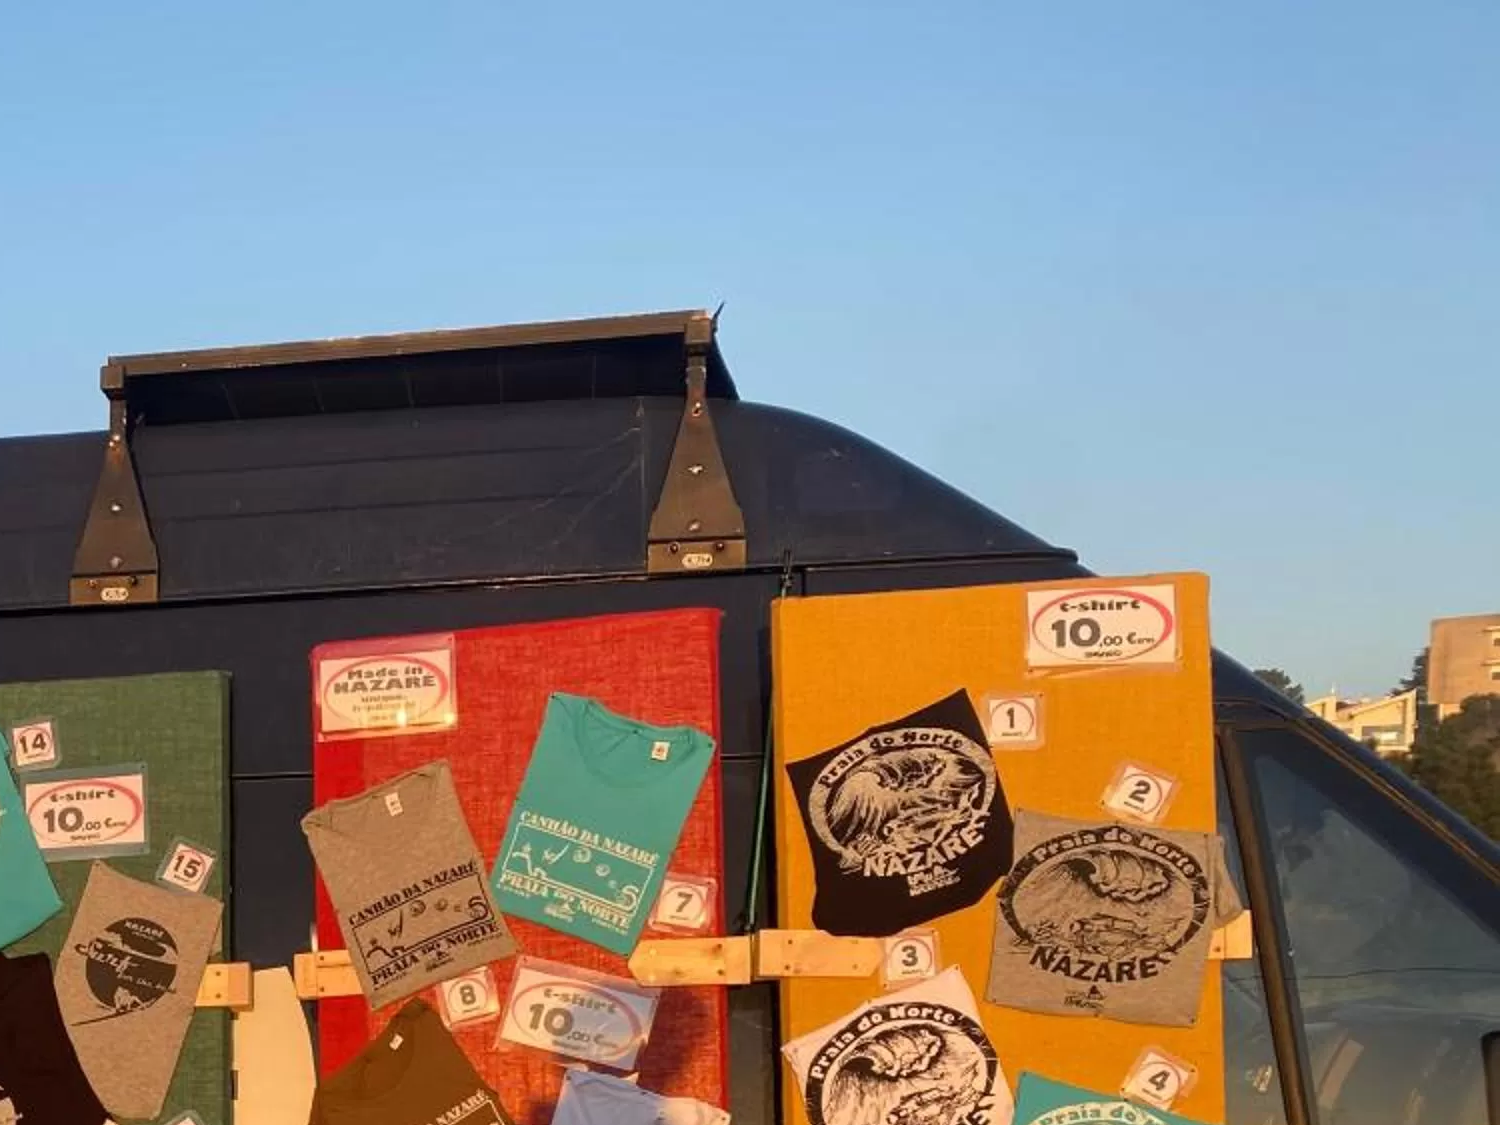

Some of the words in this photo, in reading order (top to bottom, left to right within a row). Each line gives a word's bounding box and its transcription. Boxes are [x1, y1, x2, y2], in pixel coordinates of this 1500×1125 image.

[1059, 599, 1140, 612] t-shirt
[1051, 618, 1123, 648] 10,00
[348, 667, 398, 680] Made
[404, 665, 423, 675] in
[1007, 708, 1016, 729] 1
[19, 732, 47, 754] 14
[818, 748, 864, 788] Praia
[870, 736, 894, 749] do
[902, 731, 965, 748] Norte
[50, 789, 115, 802] t-shirt
[1128, 780, 1151, 803] 2
[1033, 830, 1097, 861] Praia
[1103, 826, 1133, 842] do
[1140, 832, 1196, 874] Norte
[173, 854, 201, 878] 15
[676, 892, 693, 912] 7
[901, 946, 918, 966] 3
[460, 984, 476, 1005] 8
[544, 988, 616, 1014] t-shirt
[811, 1031, 855, 1080] Praia
[858, 1012, 883, 1031] do
[889, 1005, 956, 1025] Norte
[1149, 1070, 1170, 1092] 4
[1109, 1105, 1136, 1122] do
